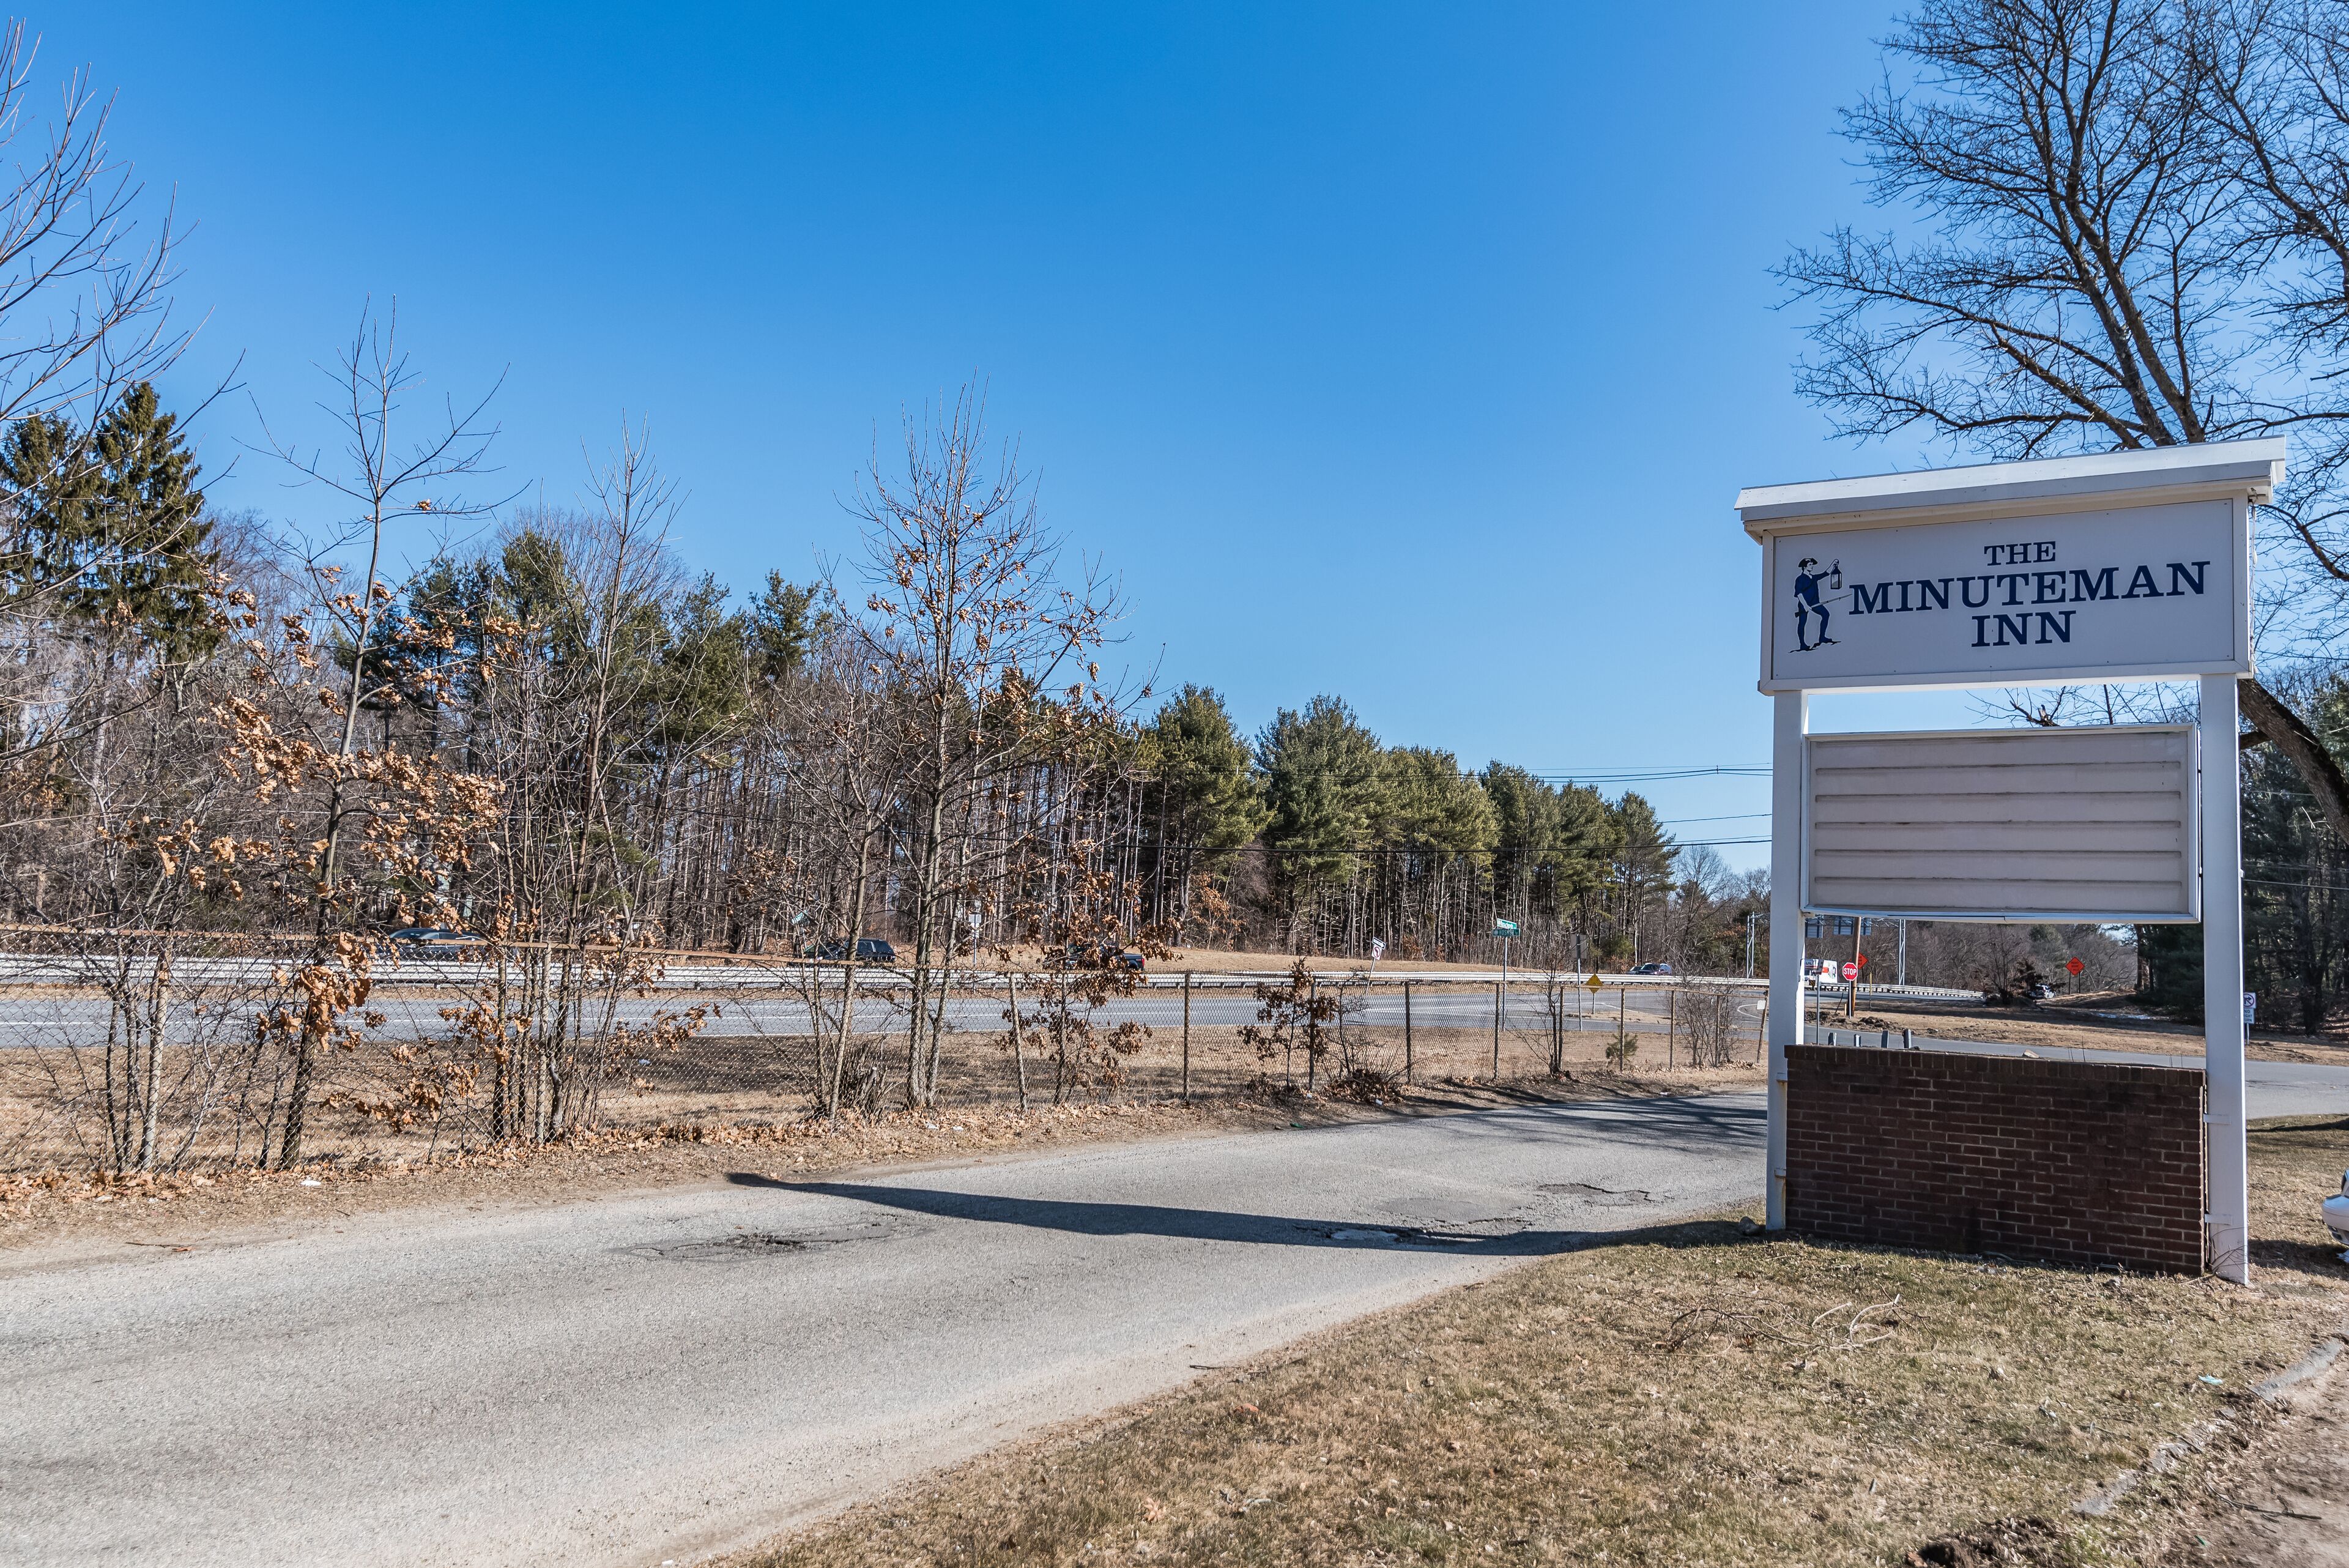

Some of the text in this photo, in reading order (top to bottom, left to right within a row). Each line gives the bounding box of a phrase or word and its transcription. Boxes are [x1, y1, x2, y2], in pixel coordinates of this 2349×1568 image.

[1984, 540, 2056, 567] THE
[1848, 560, 2211, 615] MINUTEMAN
[1971, 609, 2077, 648] INN
